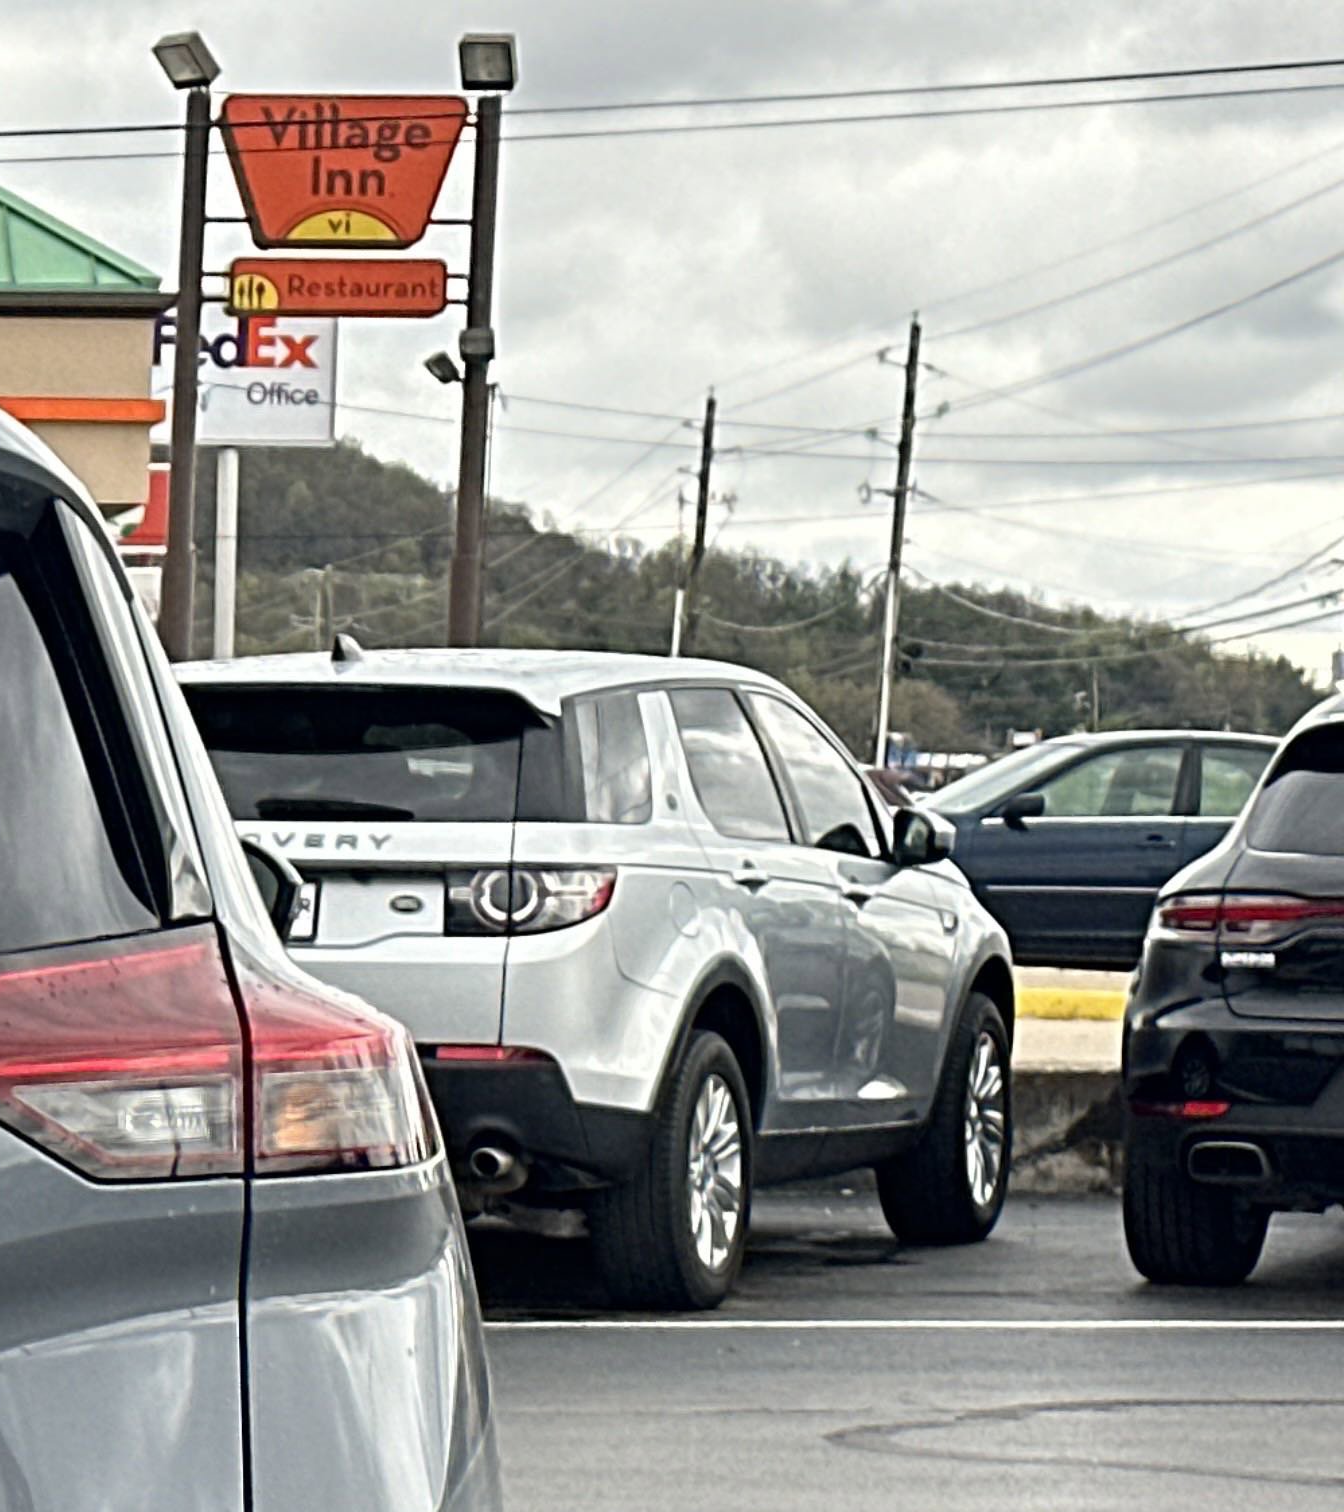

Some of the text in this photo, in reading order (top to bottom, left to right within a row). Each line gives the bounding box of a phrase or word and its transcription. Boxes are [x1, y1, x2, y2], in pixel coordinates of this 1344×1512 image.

[261, 102, 432, 162] Village
[311, 156, 386, 197] Inn
[327, 213, 351, 235] vi
[287, 275, 441, 299] Restaurant
[246, 382, 319, 406] Office
